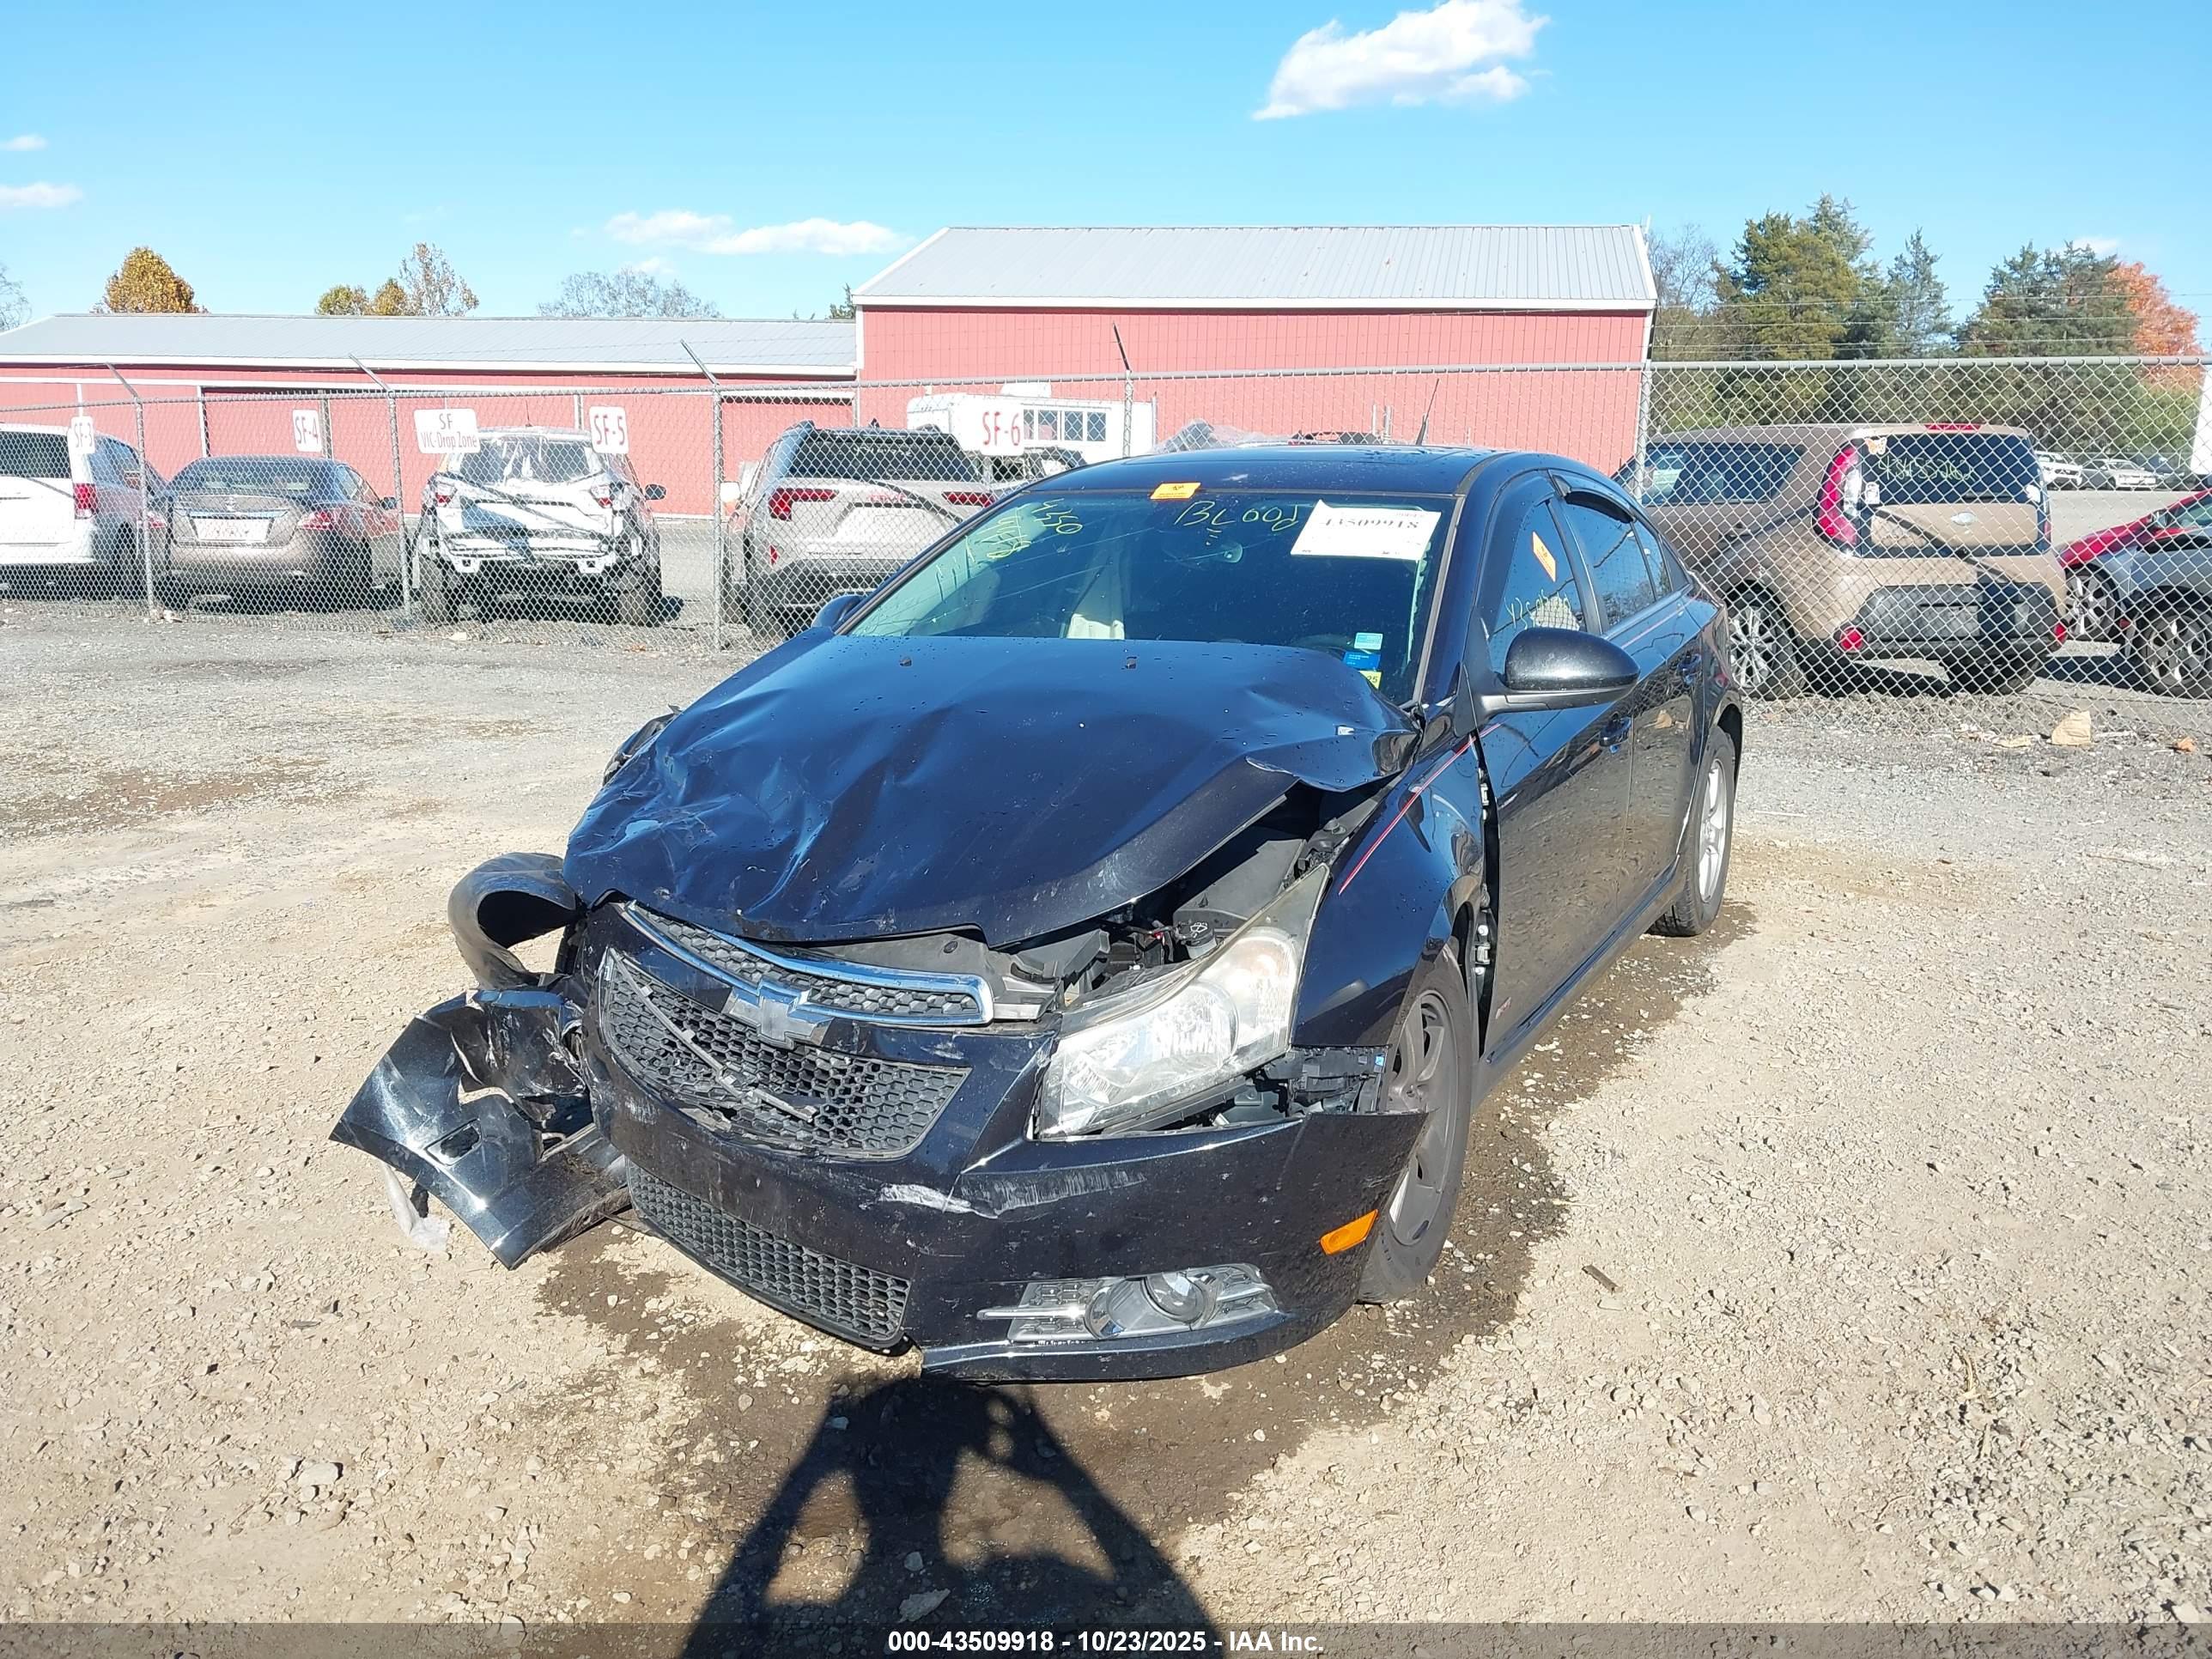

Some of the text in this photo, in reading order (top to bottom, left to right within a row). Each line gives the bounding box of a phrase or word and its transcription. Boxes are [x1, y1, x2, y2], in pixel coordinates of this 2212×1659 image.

[295, 416, 319, 444] SF-4
[439, 413, 453, 430] SF
[593, 414, 625, 445] SF-5
[982, 411, 1020, 446] SF-6
[421, 431, 477, 451] VIC-Drop Zone
